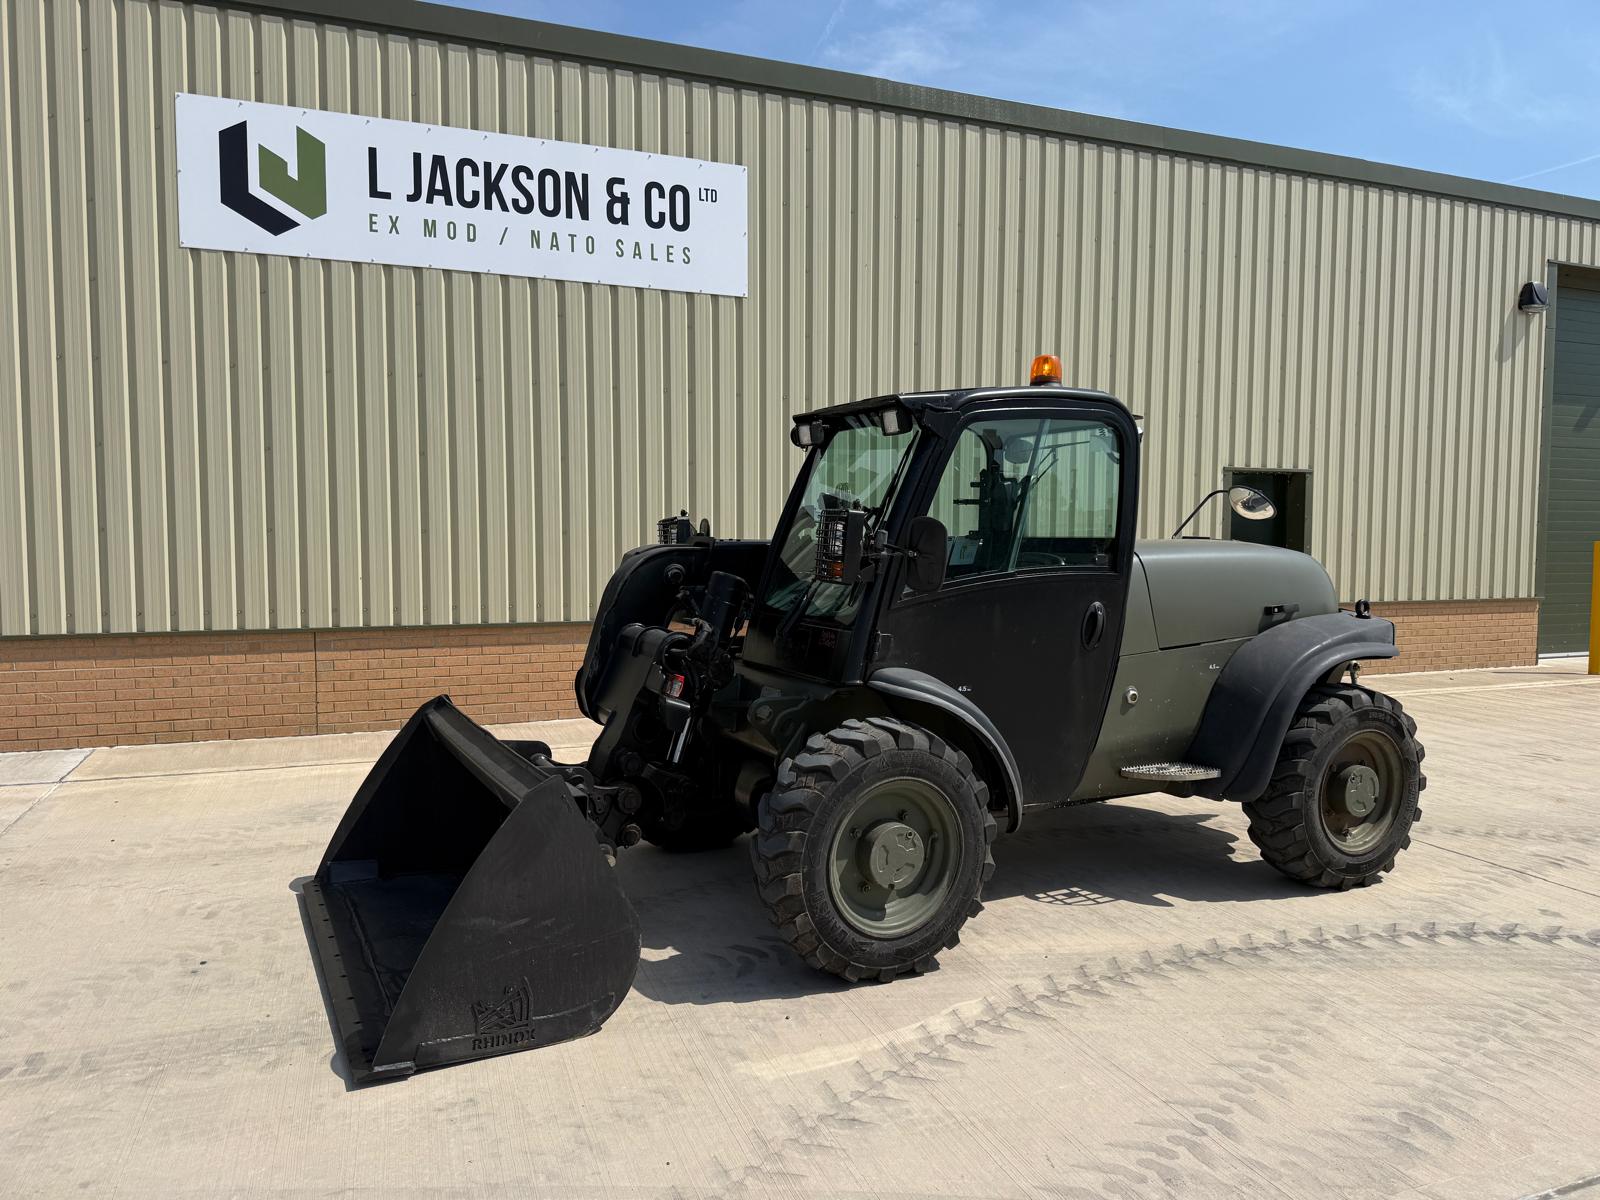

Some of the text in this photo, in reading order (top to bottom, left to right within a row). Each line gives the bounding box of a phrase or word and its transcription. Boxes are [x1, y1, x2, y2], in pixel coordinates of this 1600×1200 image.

[367, 146, 718, 233] L JACKSON & CO LTD
[368, 213, 400, 235] EX
[423, 218, 477, 243] MOD
[530, 229, 595, 255] NATO
[615, 238, 691, 265] SALES
[471, 1028, 537, 1051] RHINOX
